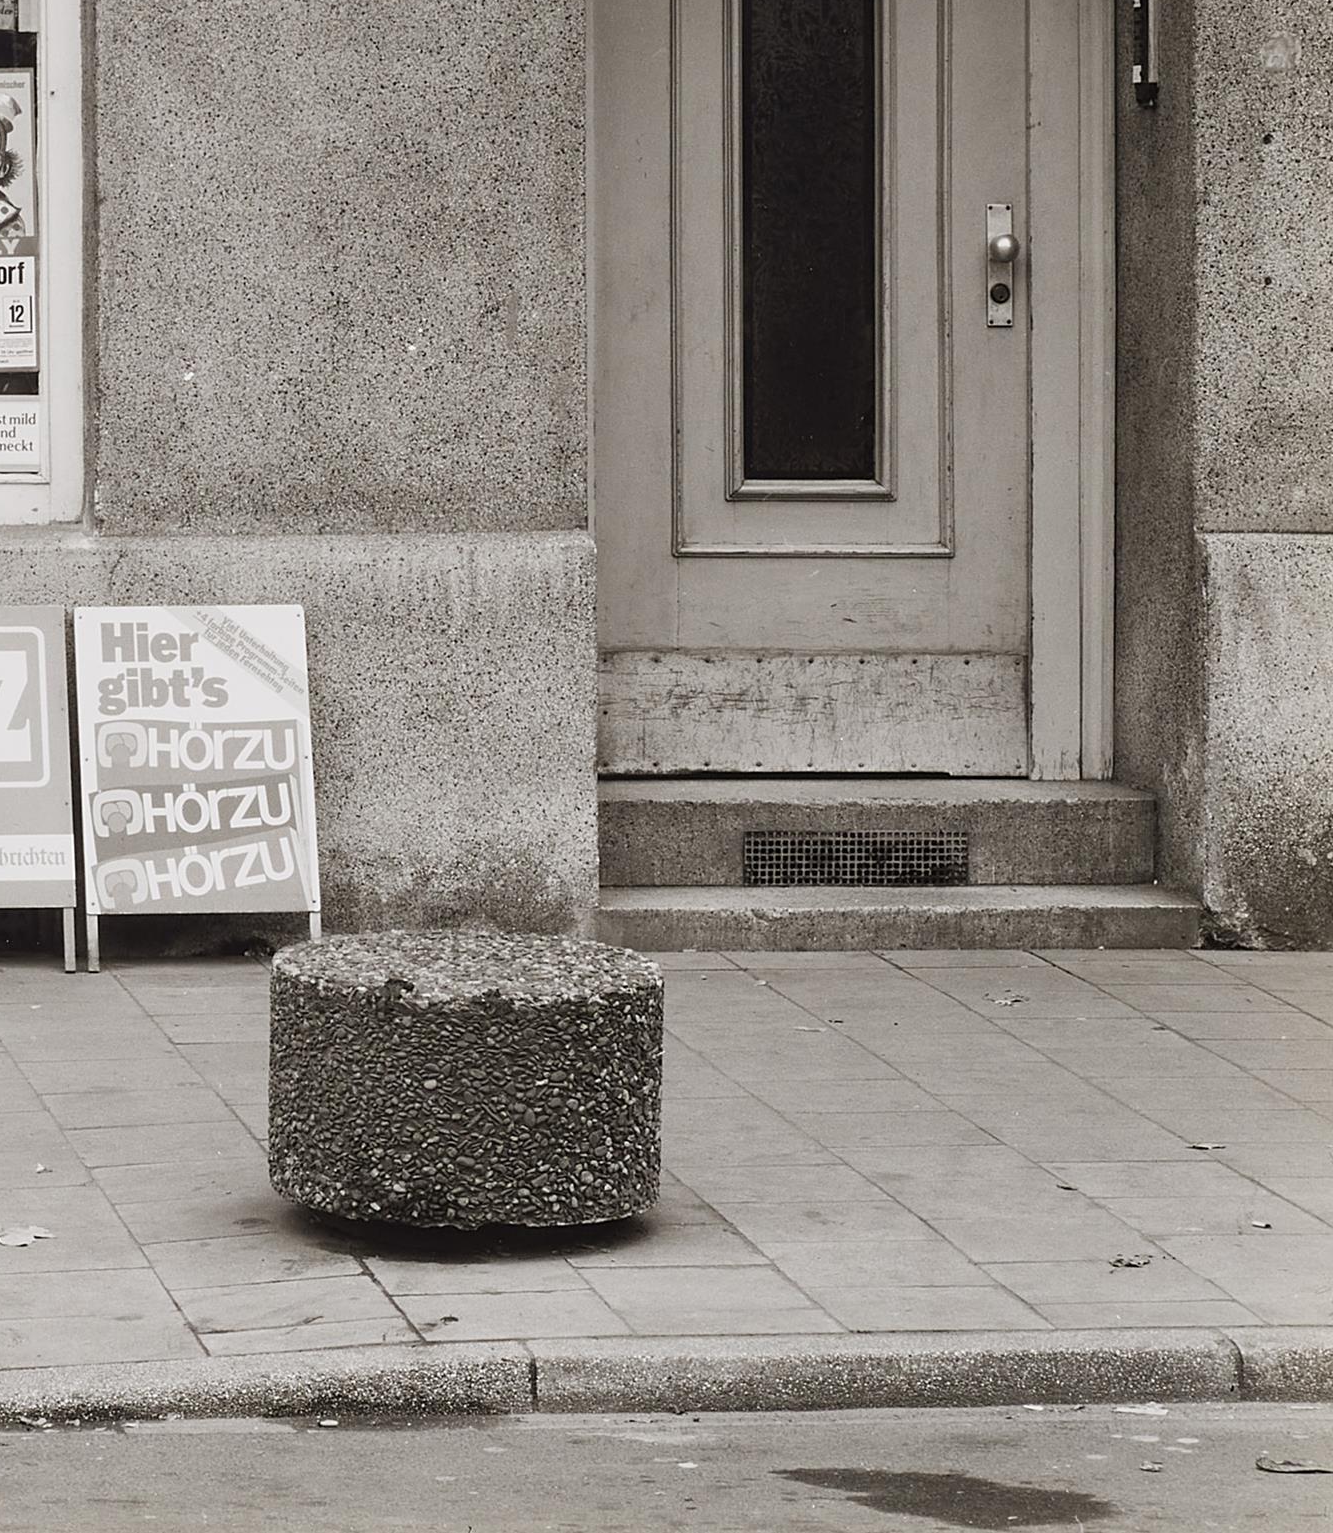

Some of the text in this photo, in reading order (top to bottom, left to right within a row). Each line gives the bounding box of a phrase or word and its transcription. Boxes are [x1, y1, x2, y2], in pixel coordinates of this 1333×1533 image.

[8, 304, 25, 323] 12
[9, 413, 36, 425] mild
[101, 622, 199, 663] Hier
